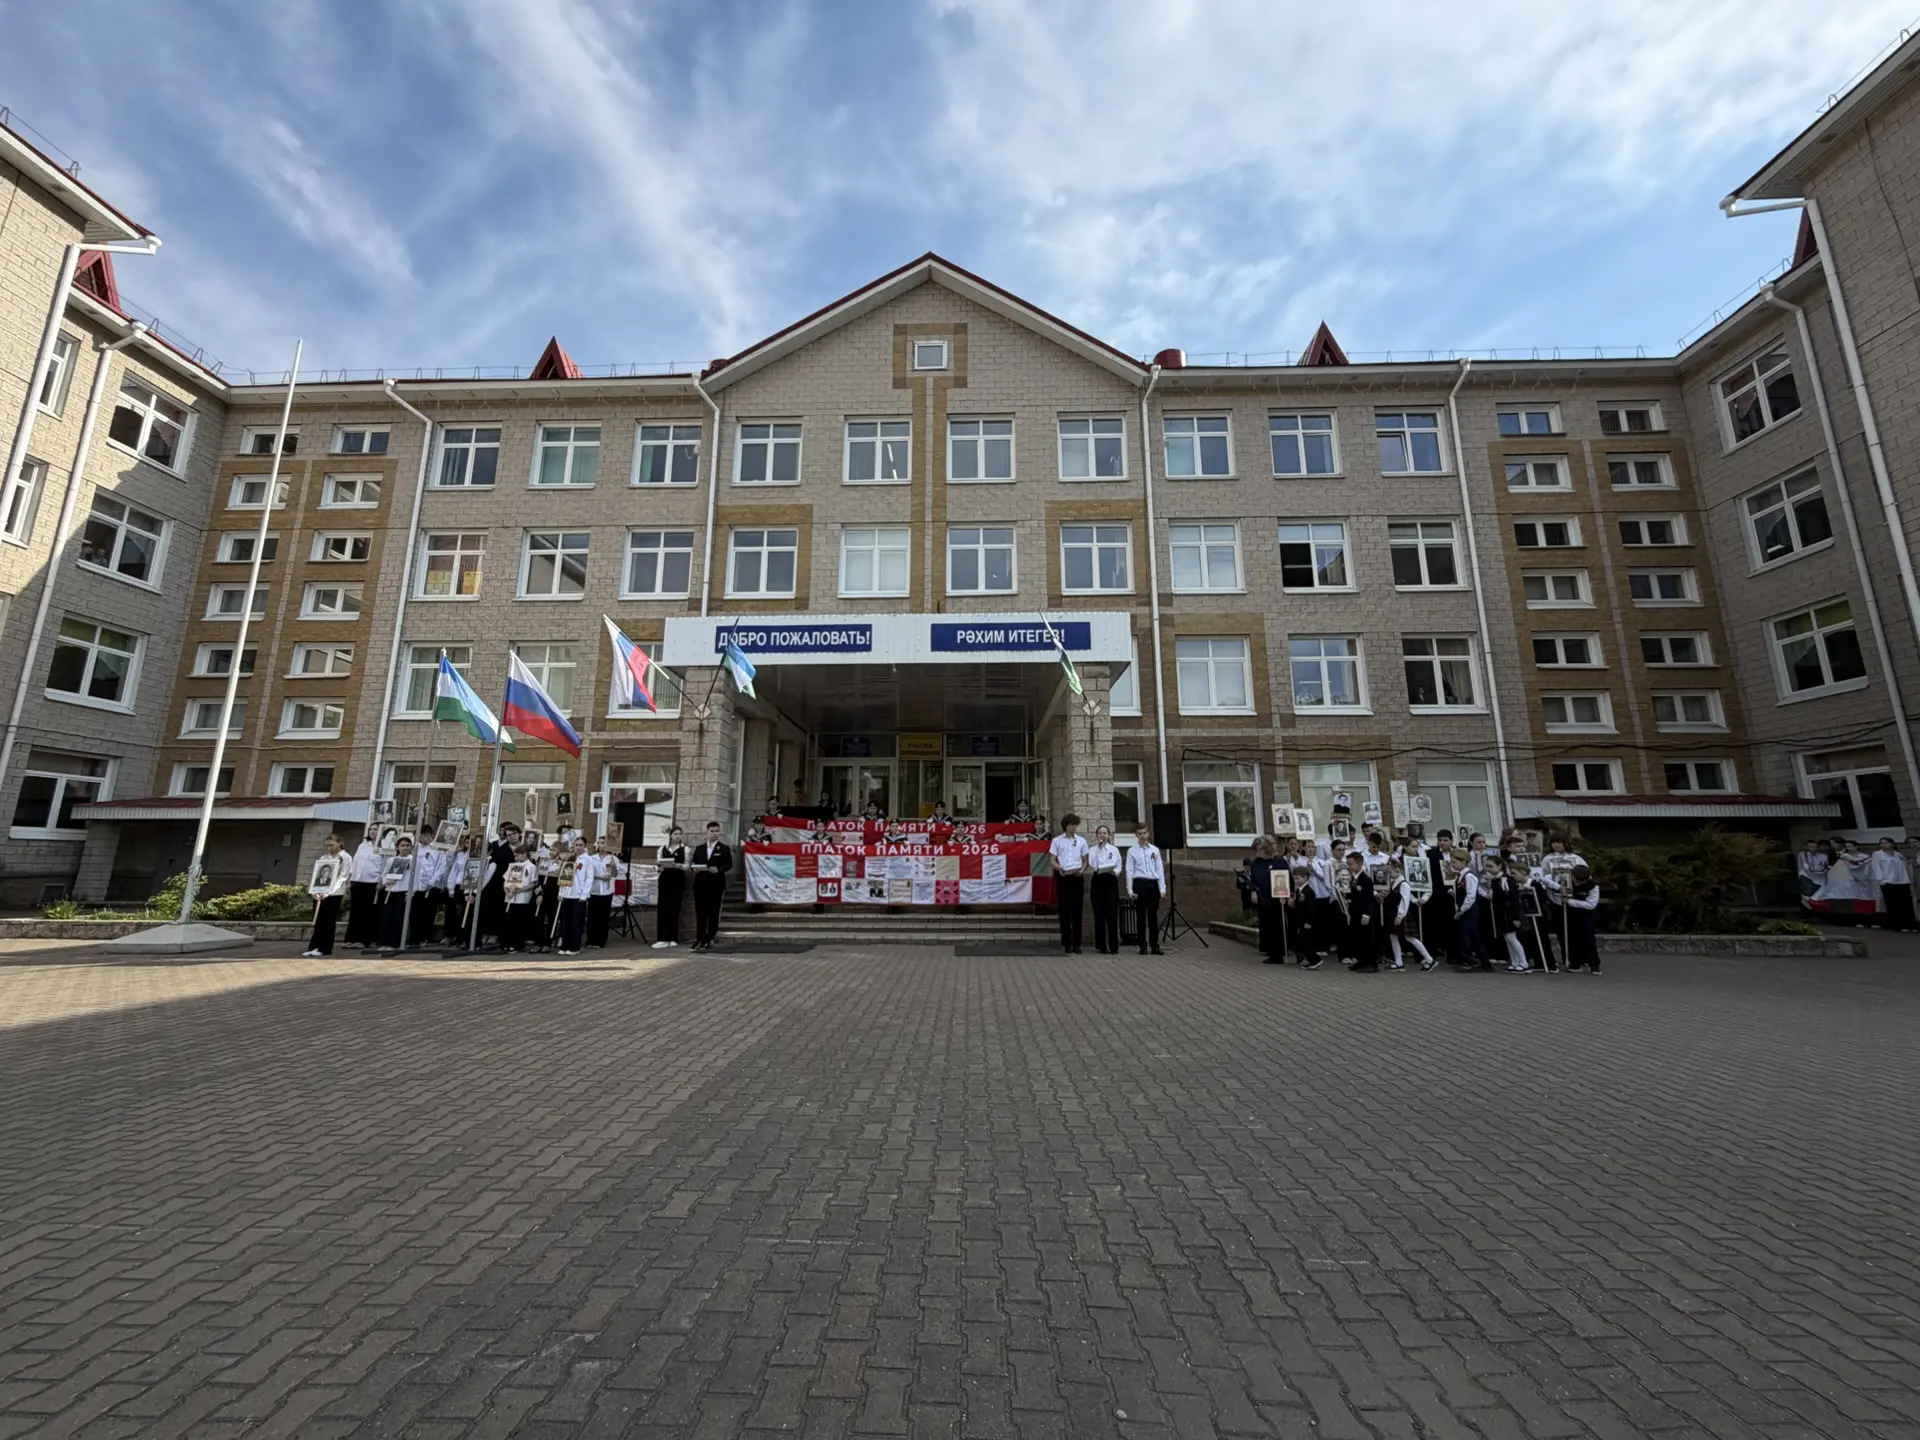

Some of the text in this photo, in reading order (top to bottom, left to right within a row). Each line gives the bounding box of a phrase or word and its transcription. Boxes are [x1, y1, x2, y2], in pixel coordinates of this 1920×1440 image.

[718, 630, 871, 649] ДОБРО ПОЖАЛОВАТЬ!
[957, 628, 1065, 644] РӘХИМ ИТЕГЕЗ!
[806, 820, 866, 832] ПАТОК
[801, 843, 867, 856] ПЛАТОК
[875, 844, 944, 856] ПАМЯТИ
[962, 843, 999, 856] 2026
